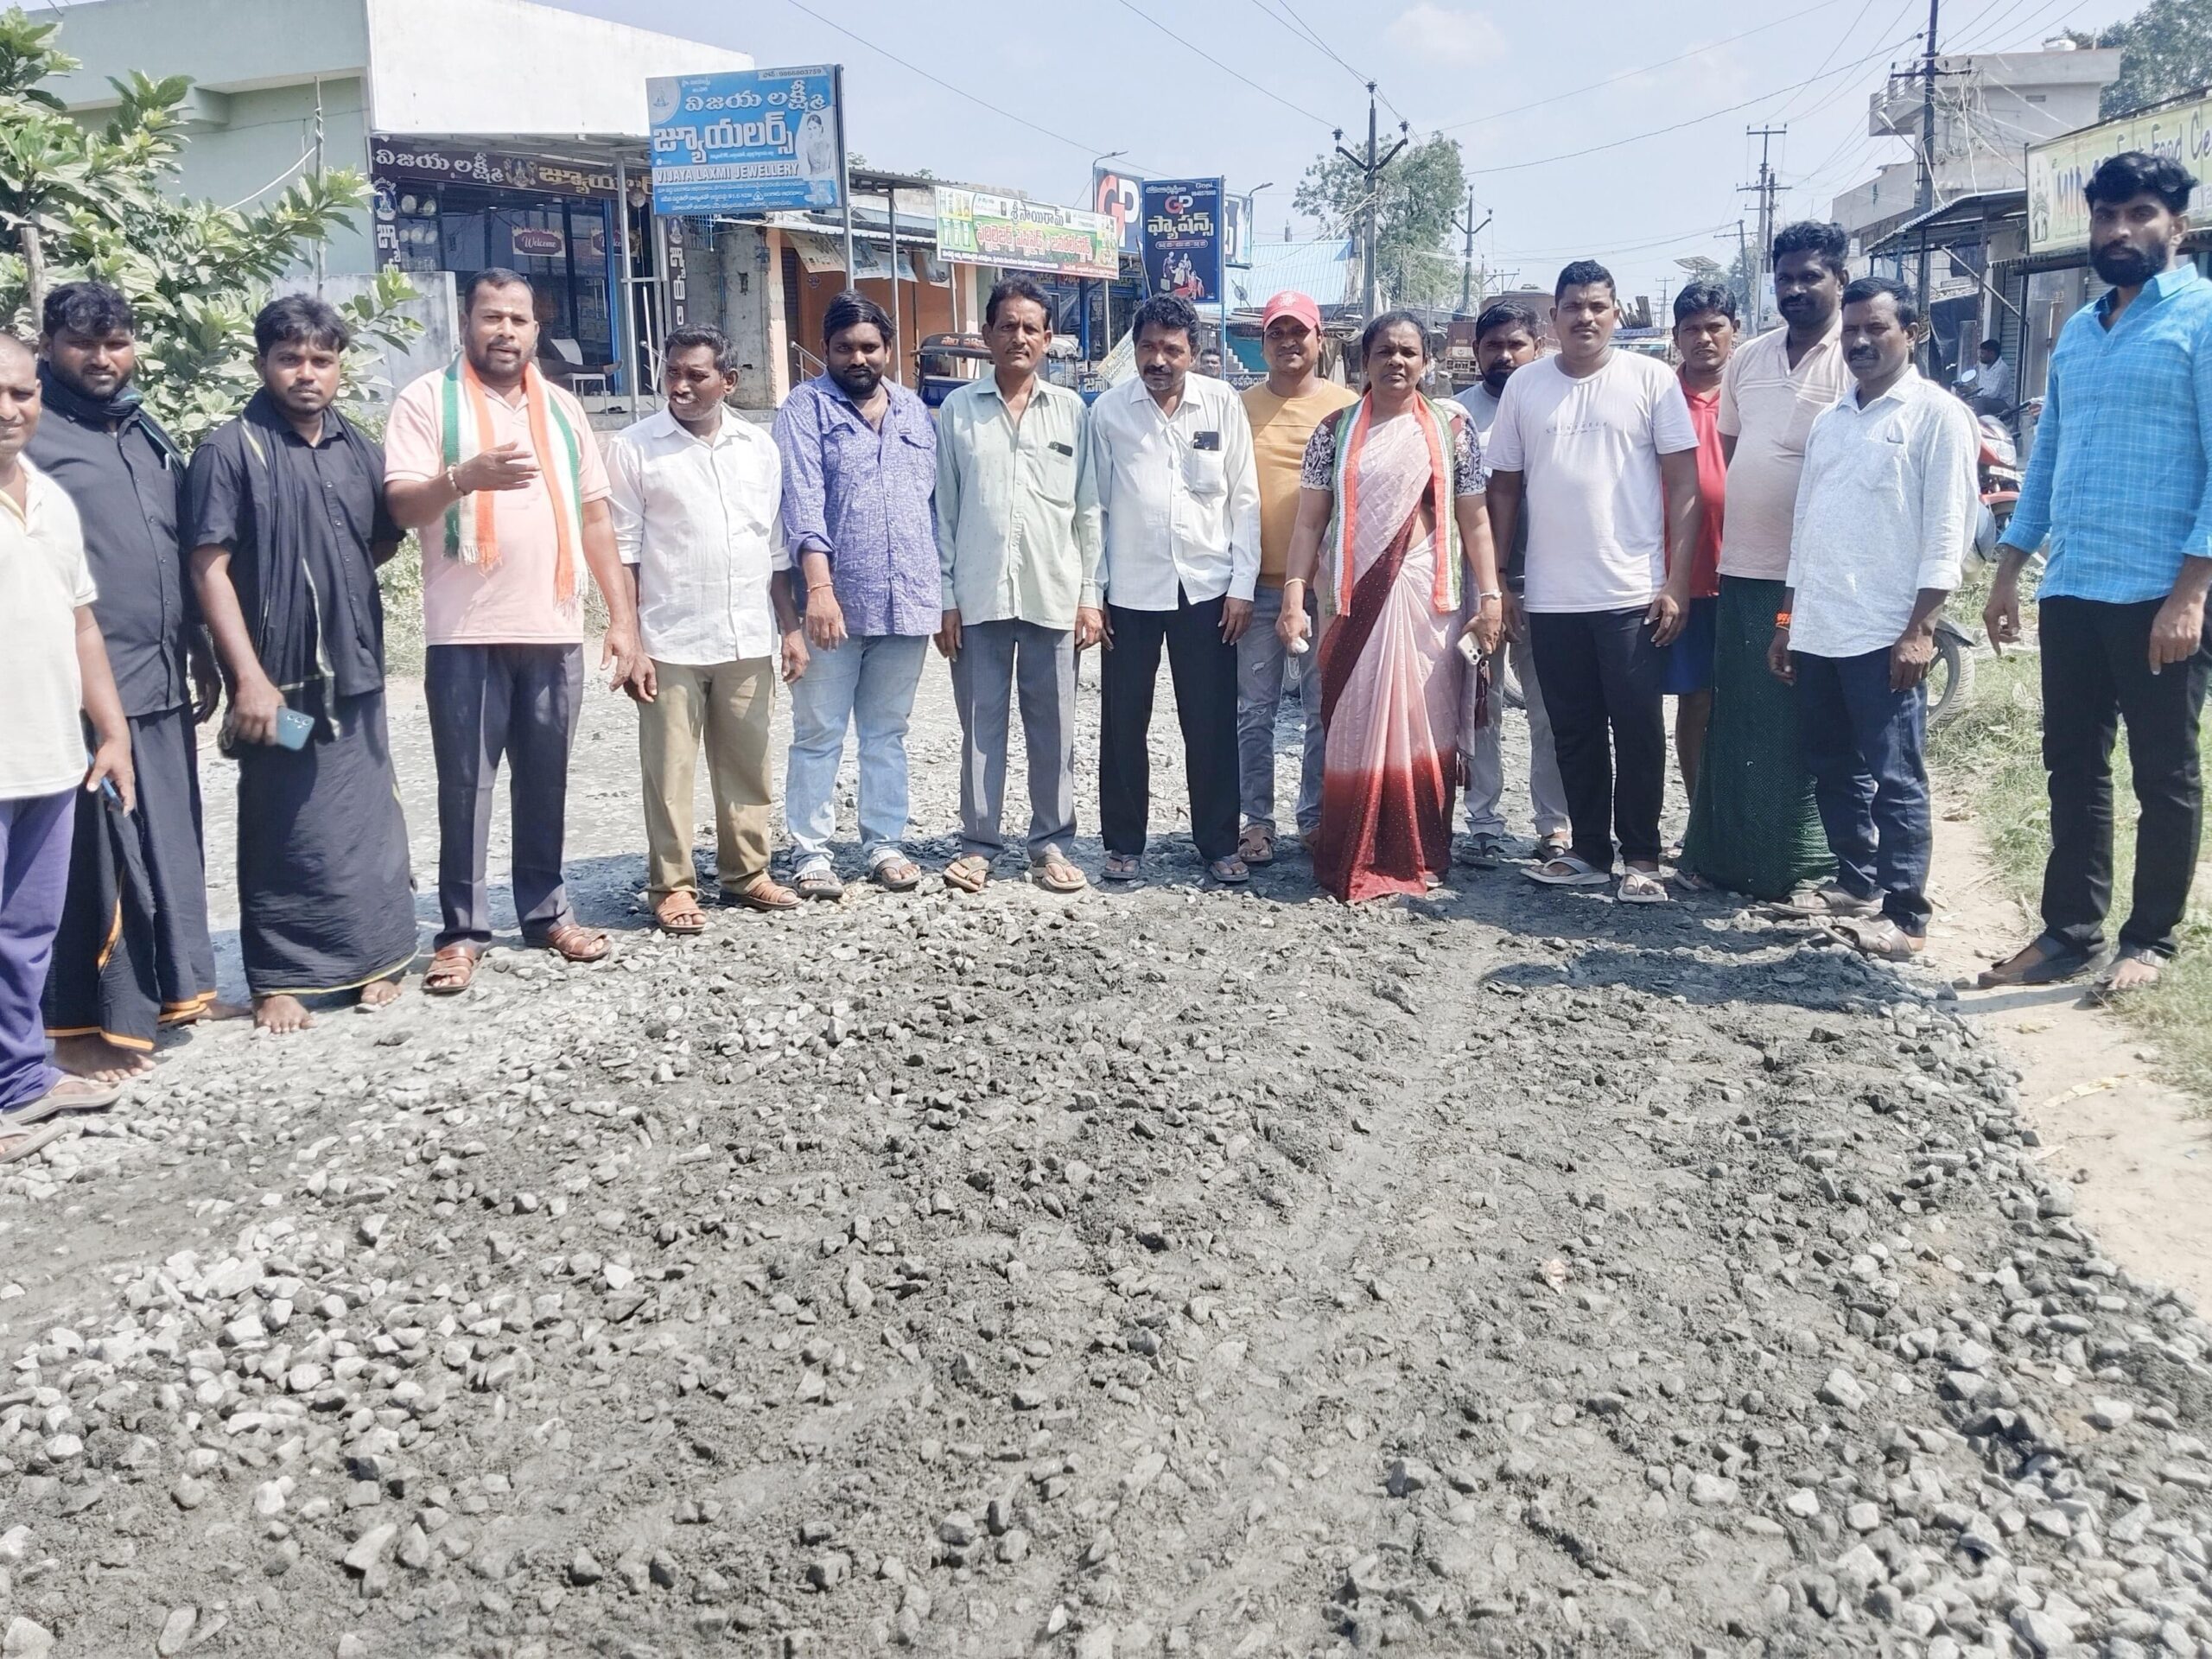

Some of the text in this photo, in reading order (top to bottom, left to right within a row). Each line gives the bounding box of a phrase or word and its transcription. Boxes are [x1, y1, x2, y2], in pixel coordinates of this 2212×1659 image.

[685, 90, 763, 111] విజయ
[376, 149, 449, 171] విజయ
[657, 163, 799, 183] VIJAYA LAXMI JEWELLERY
[1195, 182, 1214, 193] Gopi
[1165, 195, 1193, 214] GP
[522, 236, 557, 249] Welcome
